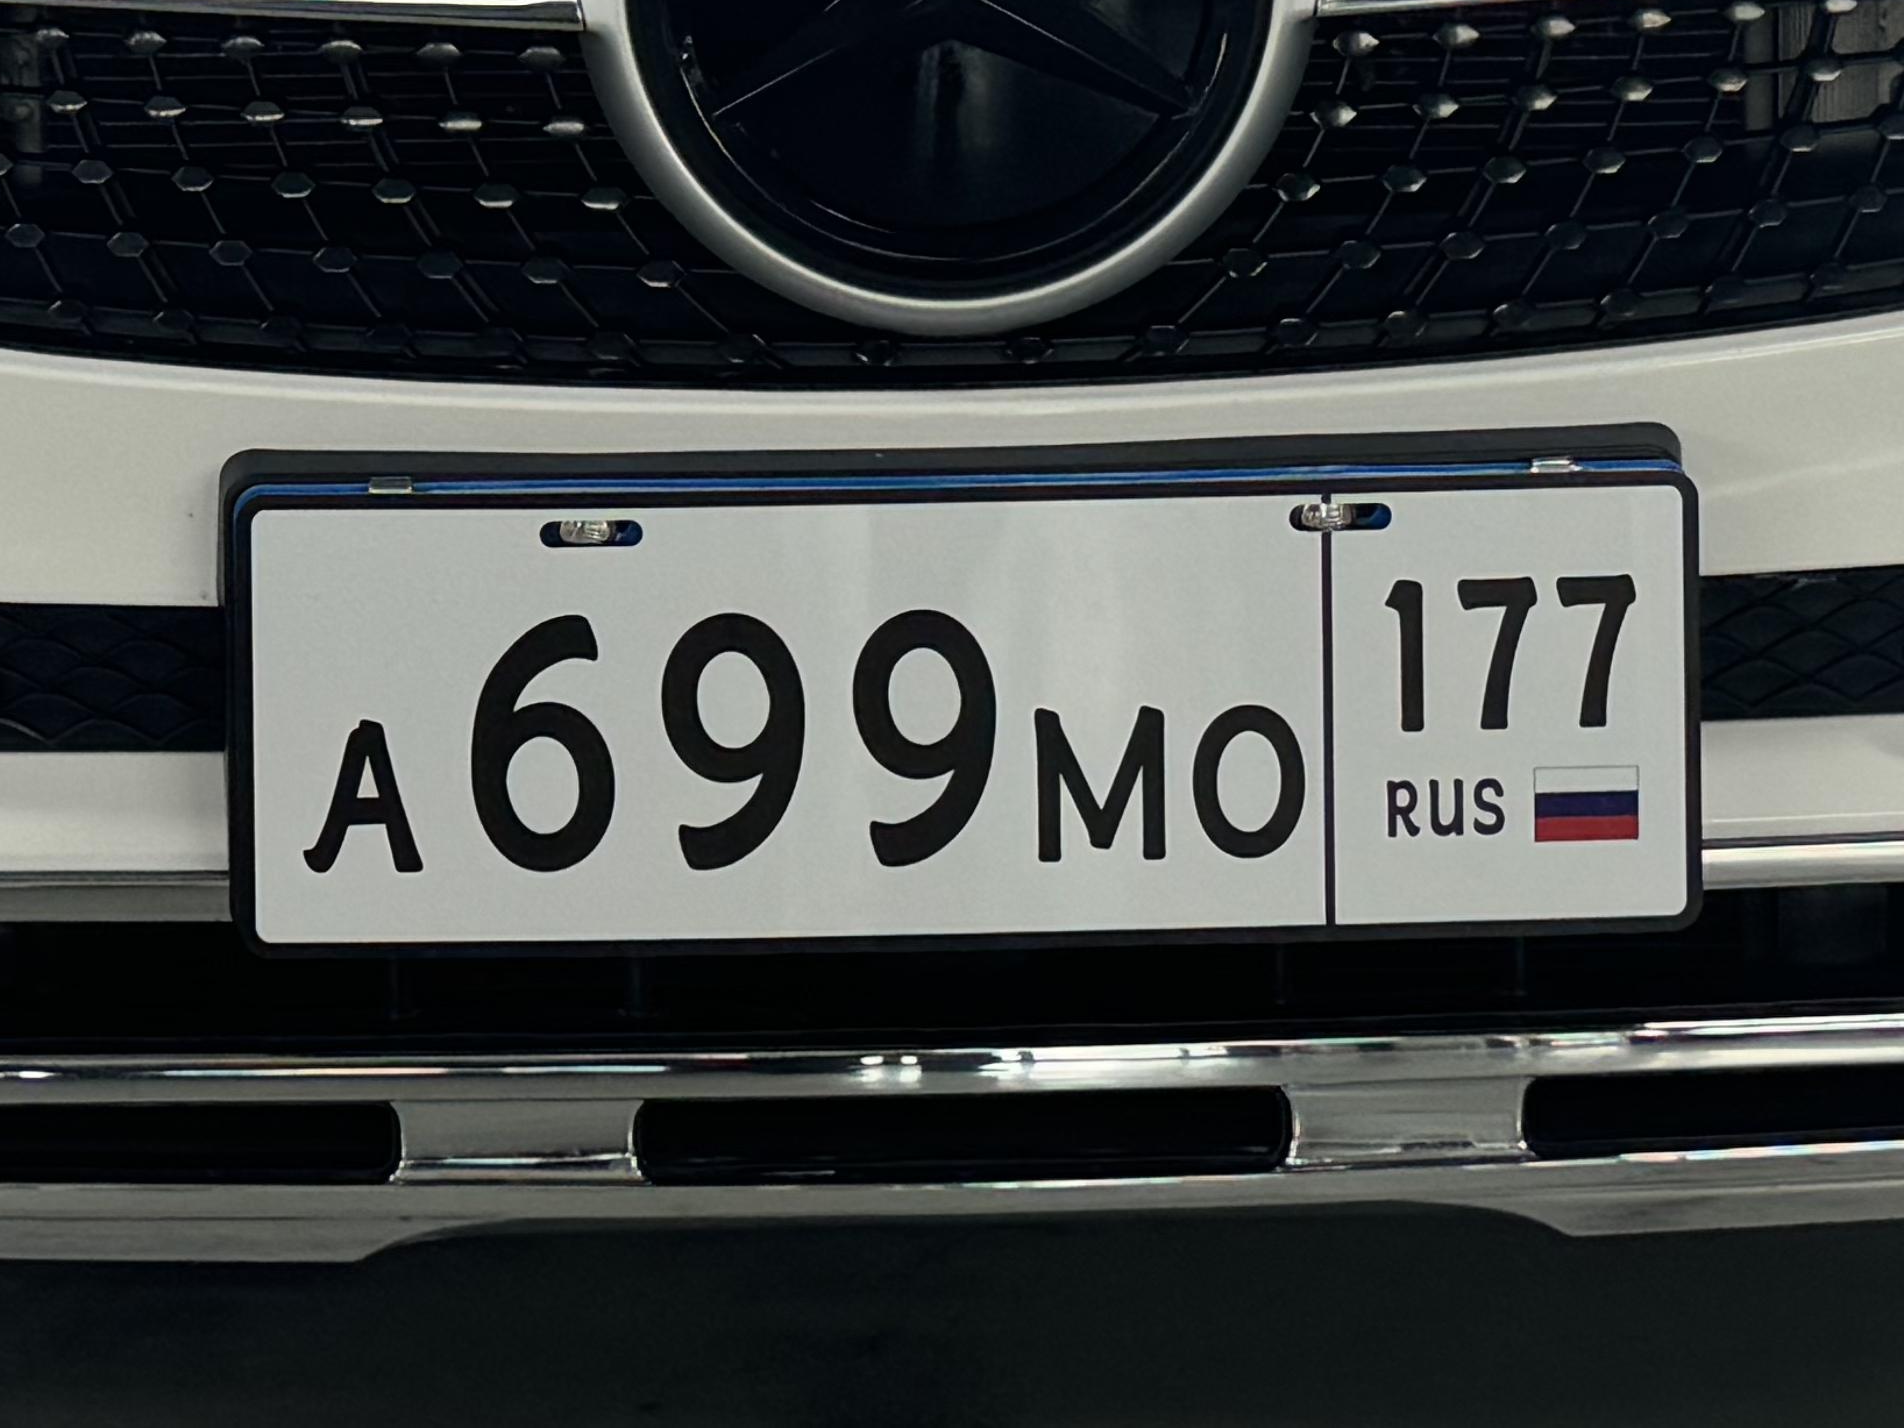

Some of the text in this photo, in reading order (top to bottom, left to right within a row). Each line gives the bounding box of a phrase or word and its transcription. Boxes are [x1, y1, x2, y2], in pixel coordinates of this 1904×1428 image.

[1382, 573, 1637, 732] 177
[301, 607, 1307, 875] A699MO
[1385, 778, 1507, 839] RUS
